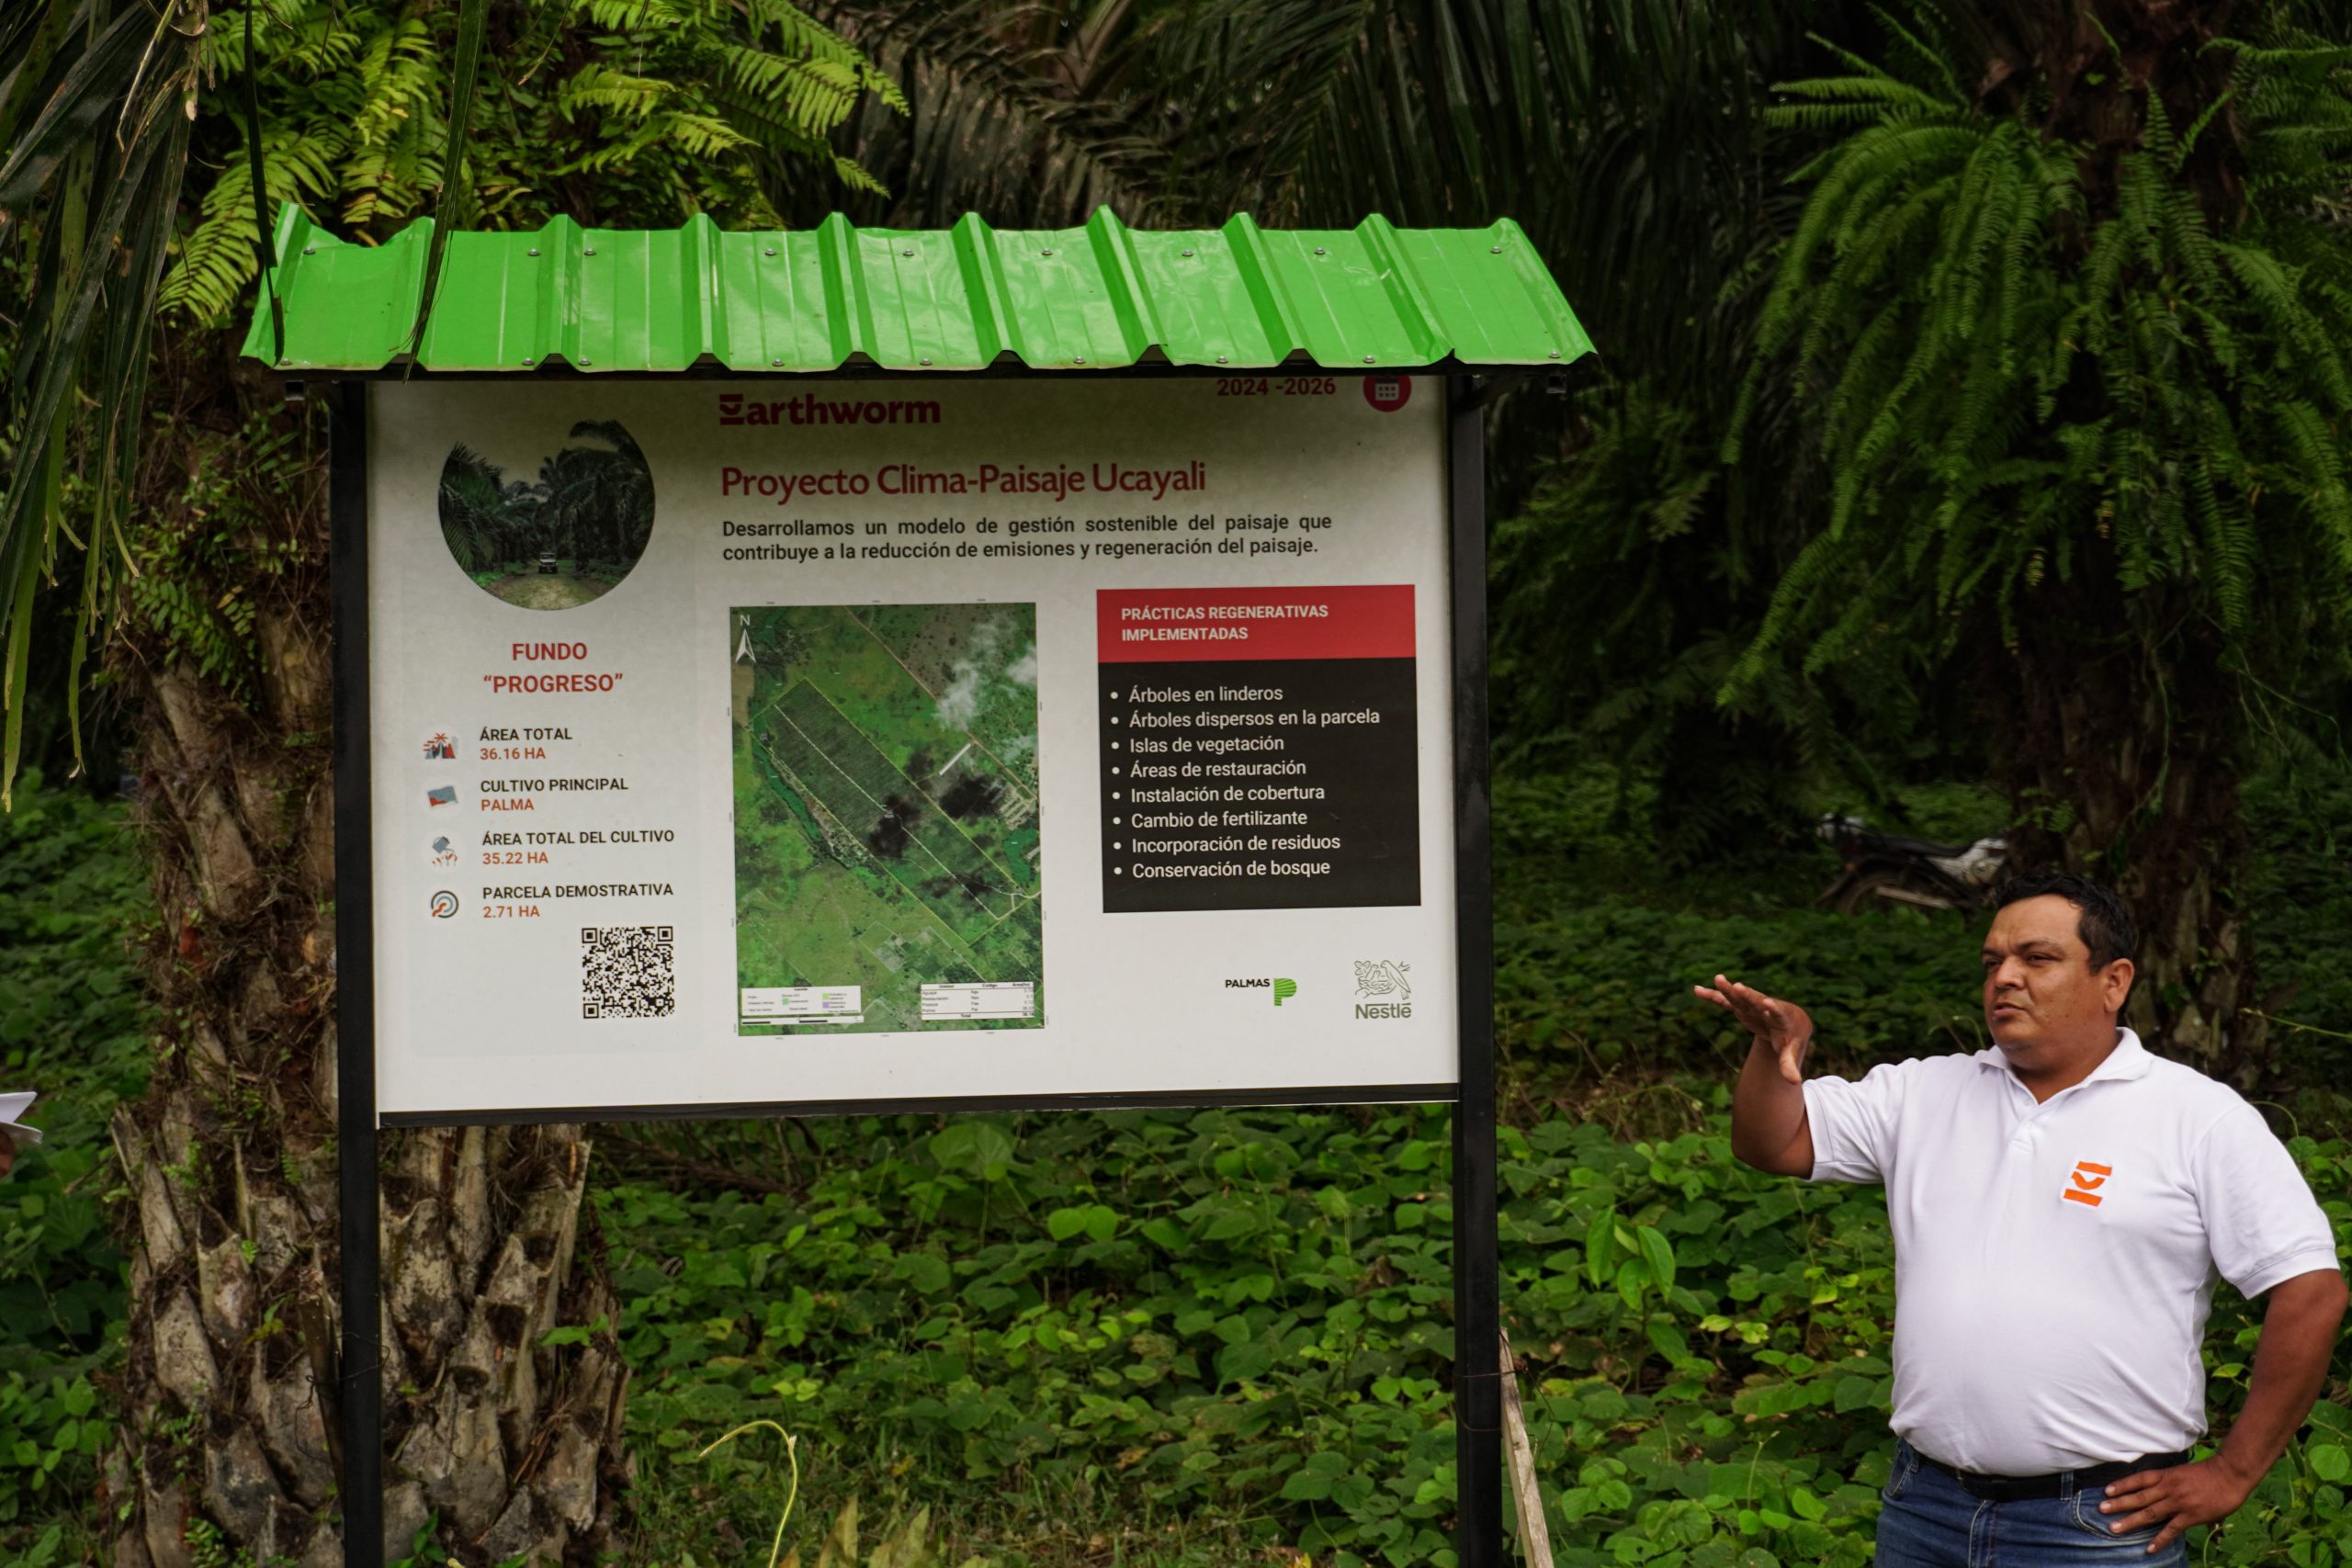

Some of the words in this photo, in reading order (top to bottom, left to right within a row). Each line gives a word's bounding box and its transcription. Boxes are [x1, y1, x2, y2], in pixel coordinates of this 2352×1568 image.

[1216, 378, 1269, 396] 2024
[721, 466, 870, 504] Proyecto
[876, 463, 1085, 502] Clima-Paisaje
[1092, 460, 1206, 501] Ucayali
[723, 520, 854, 536] Desarrollamos
[865, 523, 887, 535] un
[899, 518, 965, 534] modelo
[977, 517, 998, 533] de
[1009, 516, 1074, 536] gestión
[1086, 515, 1177, 532] sostenible
[1189, 514, 1214, 530] del
[1226, 514, 1288, 534] paisaje
[1299, 517, 1331, 532] que
[723, 544, 819, 563] contribuye
[824, 547, 834, 558] a
[841, 543, 855, 558] la
[862, 542, 950, 558] reducción
[956, 541, 978, 557] de
[983, 541, 1074, 557] emisiones
[1080, 544, 1090, 559] y
[1096, 538, 1212, 558] regeneración
[1218, 537, 1243, 553] del
[1250, 537, 1317, 557] paisaje.
[740, 615, 751, 626] N
[1122, 605, 1204, 620] PRÁCTICAS
[1209, 605, 1328, 618] REGENERATIVAS
[1123, 627, 1248, 640] IMPLEMENTADAS
[513, 643, 587, 660] FUNDO
[1129, 685, 1191, 702] Árboles
[1195, 691, 1215, 701] en
[1220, 686, 1283, 701] linderos
[1129, 710, 1191, 728] Árboles
[1195, 712, 1273, 729] dispersos
[1279, 714, 1297, 725] en
[1303, 709, 1316, 724] la
[1321, 708, 1380, 728] parcela
[480, 727, 519, 740] ÁREA
[523, 728, 572, 740] TOTAL
[481, 748, 520, 760] 36.16
[525, 748, 546, 759] HA
[1131, 738, 1168, 752] Islas
[1172, 738, 1192, 751] de
[1196, 736, 1283, 755] vegetación
[1130, 761, 1177, 777] Áreas
[1182, 761, 1201, 776] de
[1206, 760, 1306, 776] restauración
[481, 780, 544, 792] CULTIVO
[549, 778, 628, 791] PRINCIPAL
[1132, 786, 1219, 802] Instalación
[1224, 786, 1243, 801] de
[1248, 785, 1325, 800] cobertura
[481, 798, 534, 810] PALMA
[1132, 812, 1193, 828] Cambio
[1198, 812, 1217, 827] de
[1222, 810, 1307, 826] fertilizante
[482, 831, 522, 845] ÁREA
[526, 832, 575, 844] TOTAL
[580, 831, 606, 843] DEL
[611, 830, 673, 842] CULTIVO
[1133, 836, 1243, 855] Incorporación
[1248, 836, 1267, 850] de
[1272, 834, 1340, 850] residuos
[483, 852, 523, 864] 35.22
[527, 852, 548, 863] HA
[1133, 861, 1242, 878] Conservación
[1247, 861, 1266, 875] de
[1271, 860, 1330, 877] bosque
[483, 886, 551, 899] PARCELA
[556, 884, 673, 897] DEMOSTRATIVA
[483, 906, 512, 918] 2.71
[519, 906, 540, 917] HA
[1226, 978, 1270, 988] PALMAS
